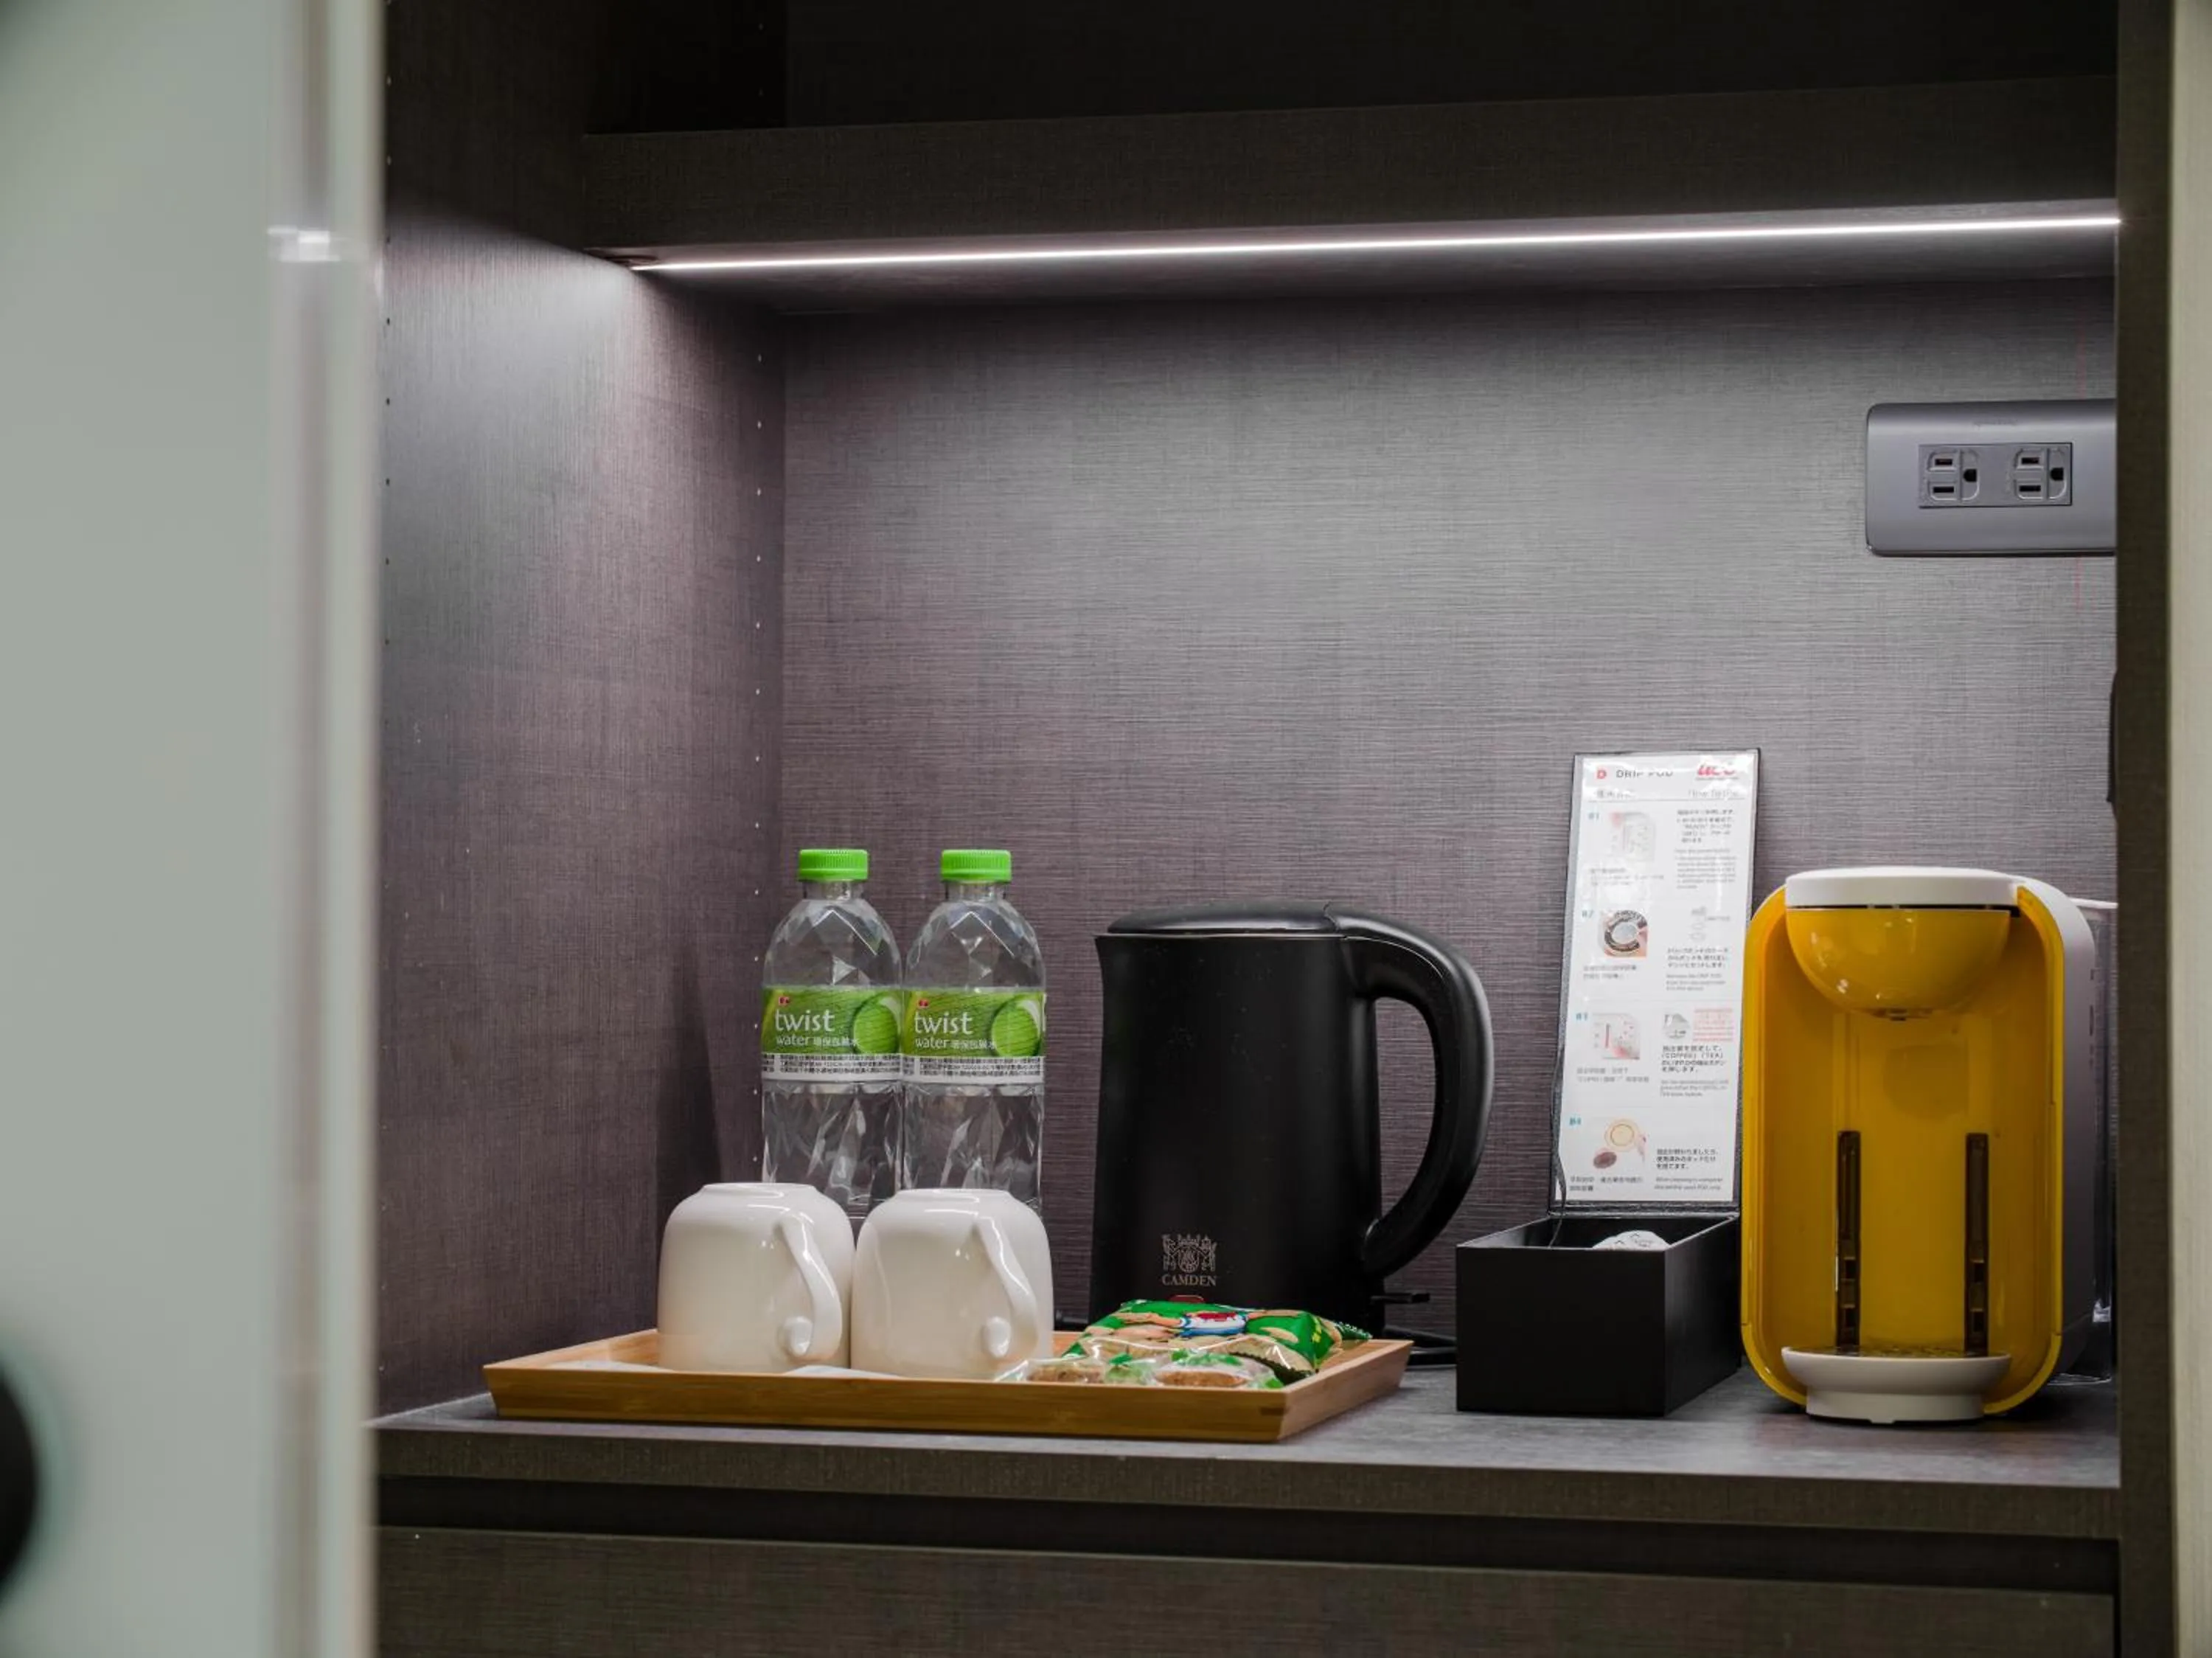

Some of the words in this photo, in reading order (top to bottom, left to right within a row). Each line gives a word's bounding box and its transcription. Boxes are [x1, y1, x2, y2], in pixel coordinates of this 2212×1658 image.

[776, 1010, 835, 1032] twist
[914, 1012, 973, 1036] twist
[776, 1034, 810, 1047] water
[916, 1036, 950, 1050] water
[1162, 1274, 1217, 1286] CAMDEN
